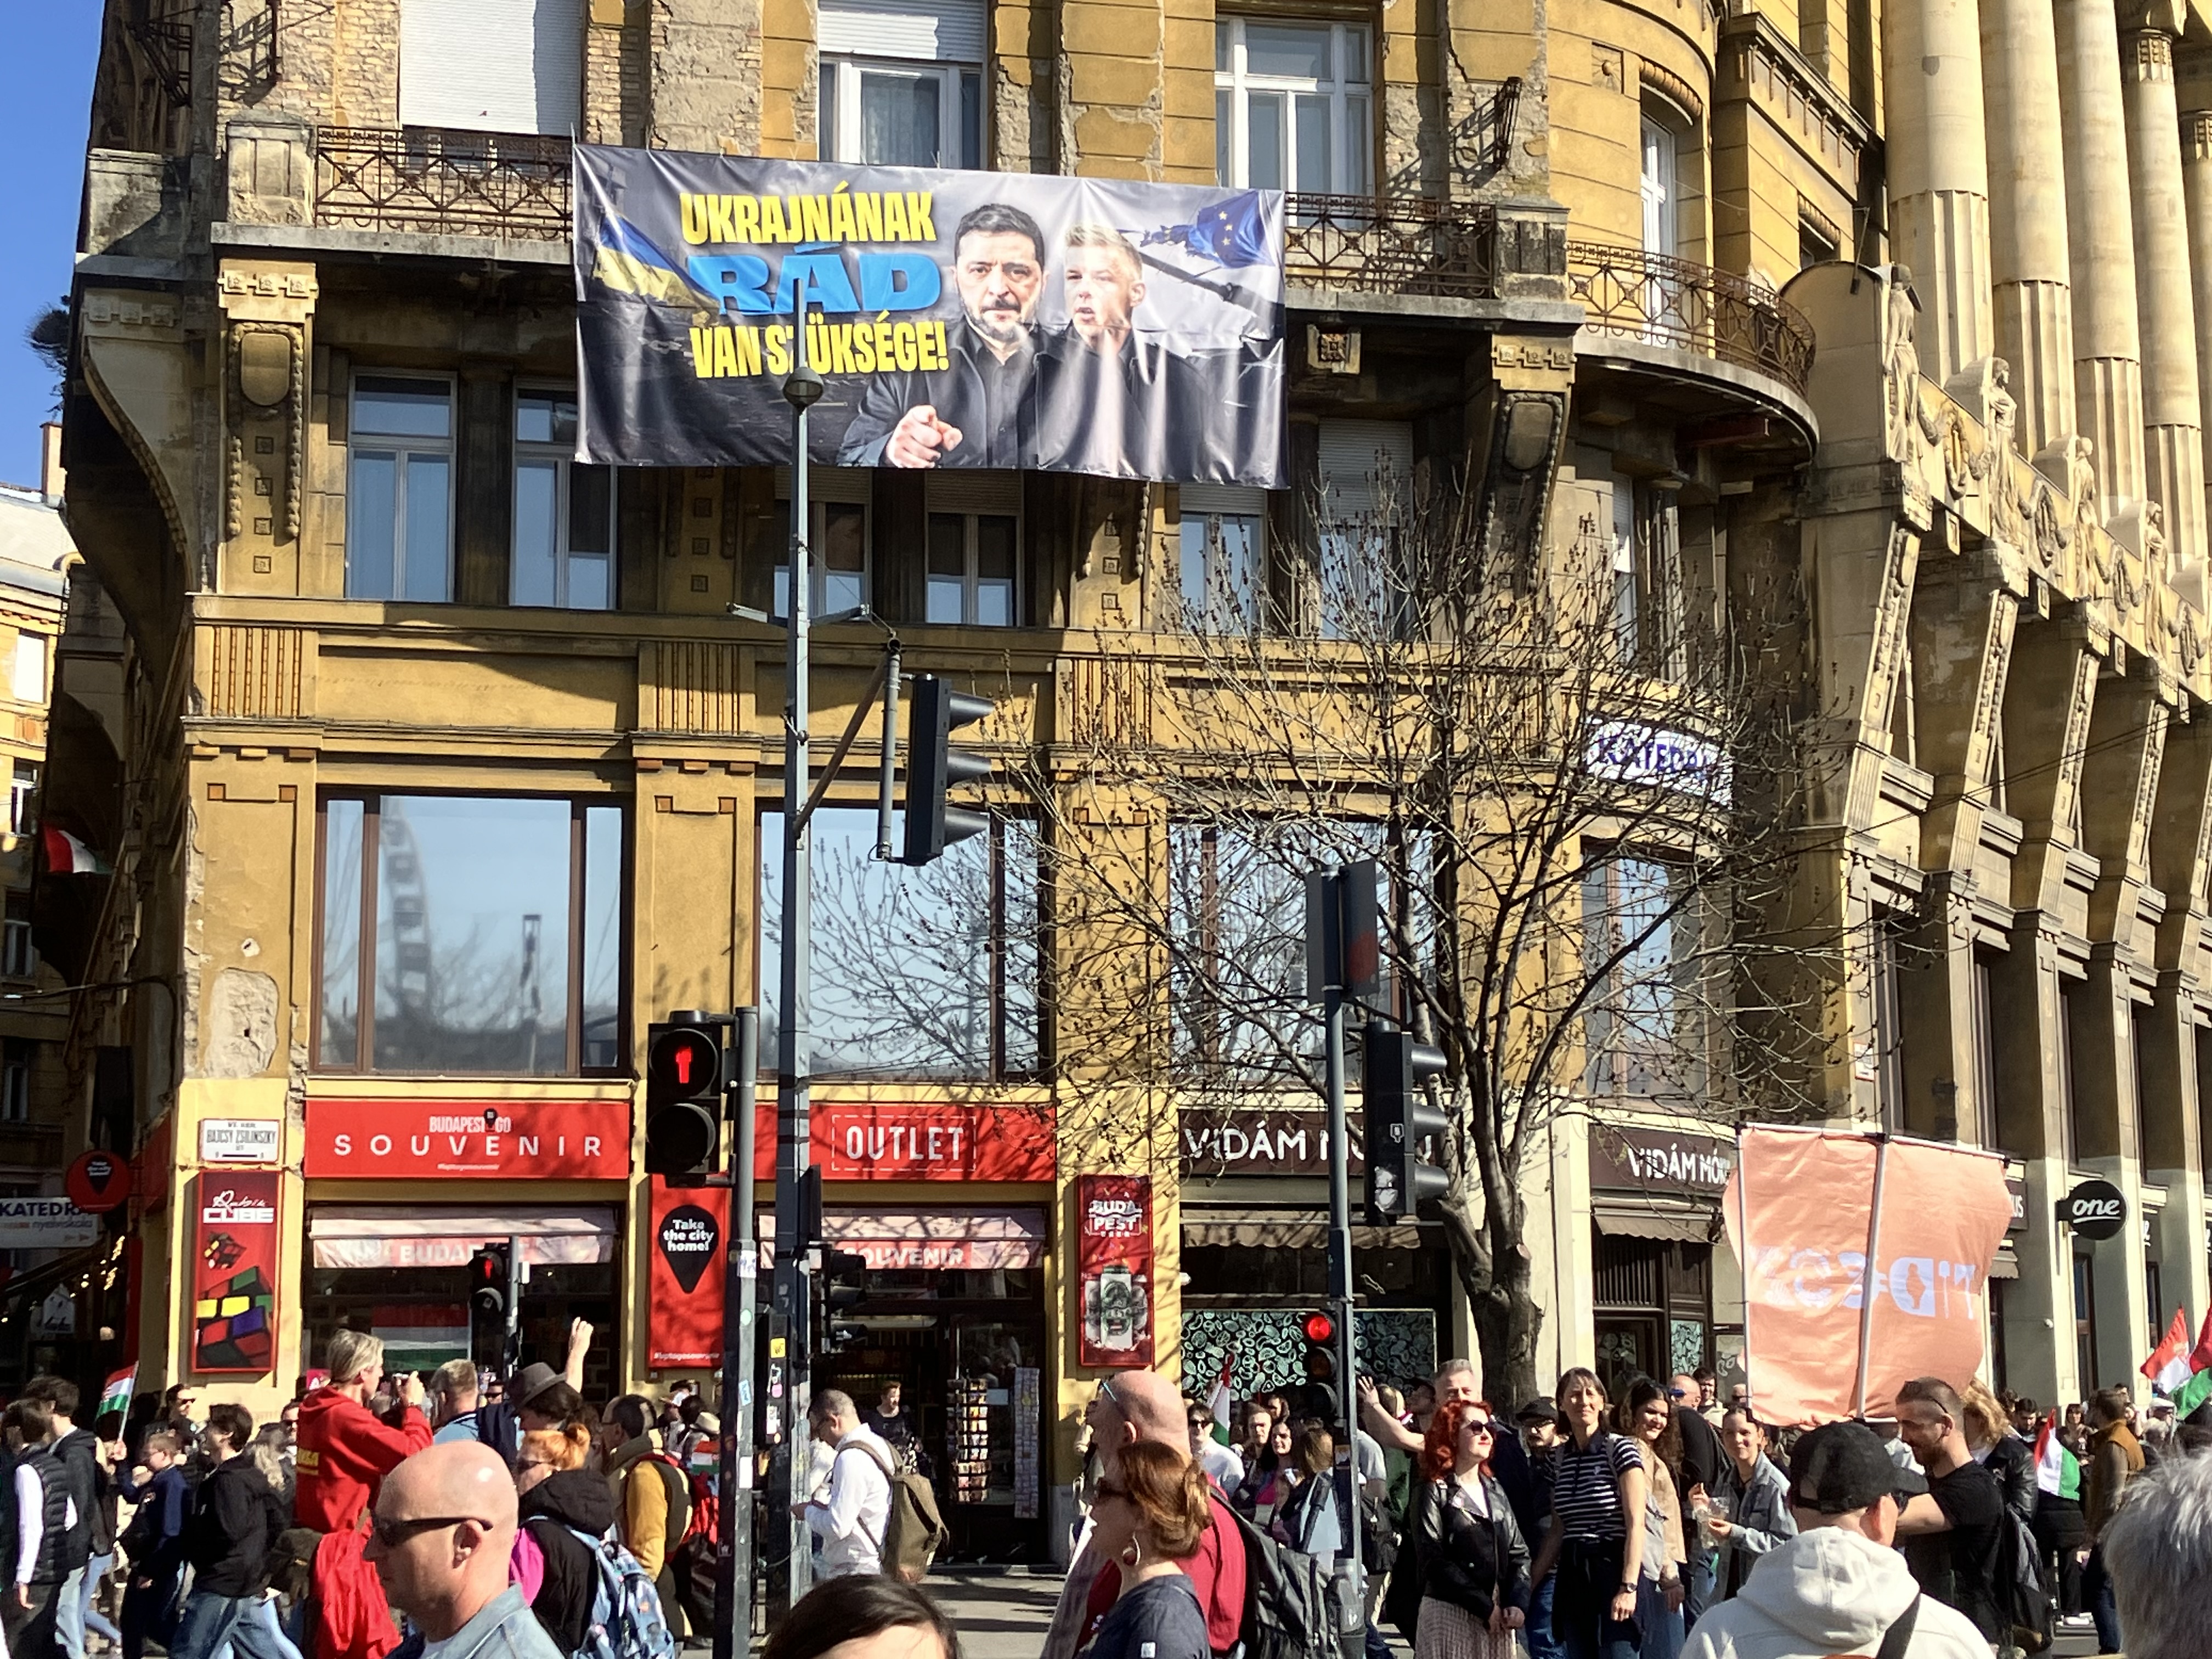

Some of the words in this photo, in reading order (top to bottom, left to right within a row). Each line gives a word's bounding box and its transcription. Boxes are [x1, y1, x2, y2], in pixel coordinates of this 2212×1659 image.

[680, 181, 936, 245] UKRAJNÁNAK
[688, 241, 941, 315] RÁD
[689, 325, 762, 379] VAN
[429, 1116, 485, 1133] BUDAPEST
[495, 1116, 512, 1133] GO
[334, 1133, 602, 1156] SOUVENIR
[846, 1125, 964, 1160] OUTLET
[1184, 1120, 1307, 1160] VIDÁM
[1627, 1142, 1696, 1182] VIDÁM
[0, 1202, 81, 1216] KATEDR
[203, 1207, 274, 1223] CUBE
[1090, 1200, 1136, 1214] BUDA
[2072, 1199, 2120, 1216] one
[672, 1218, 704, 1230] Take
[1093, 1217, 1137, 1231] PEST
[663, 1229, 686, 1240] the
[689, 1229, 714, 1243] city
[667, 1240, 709, 1251] home!
